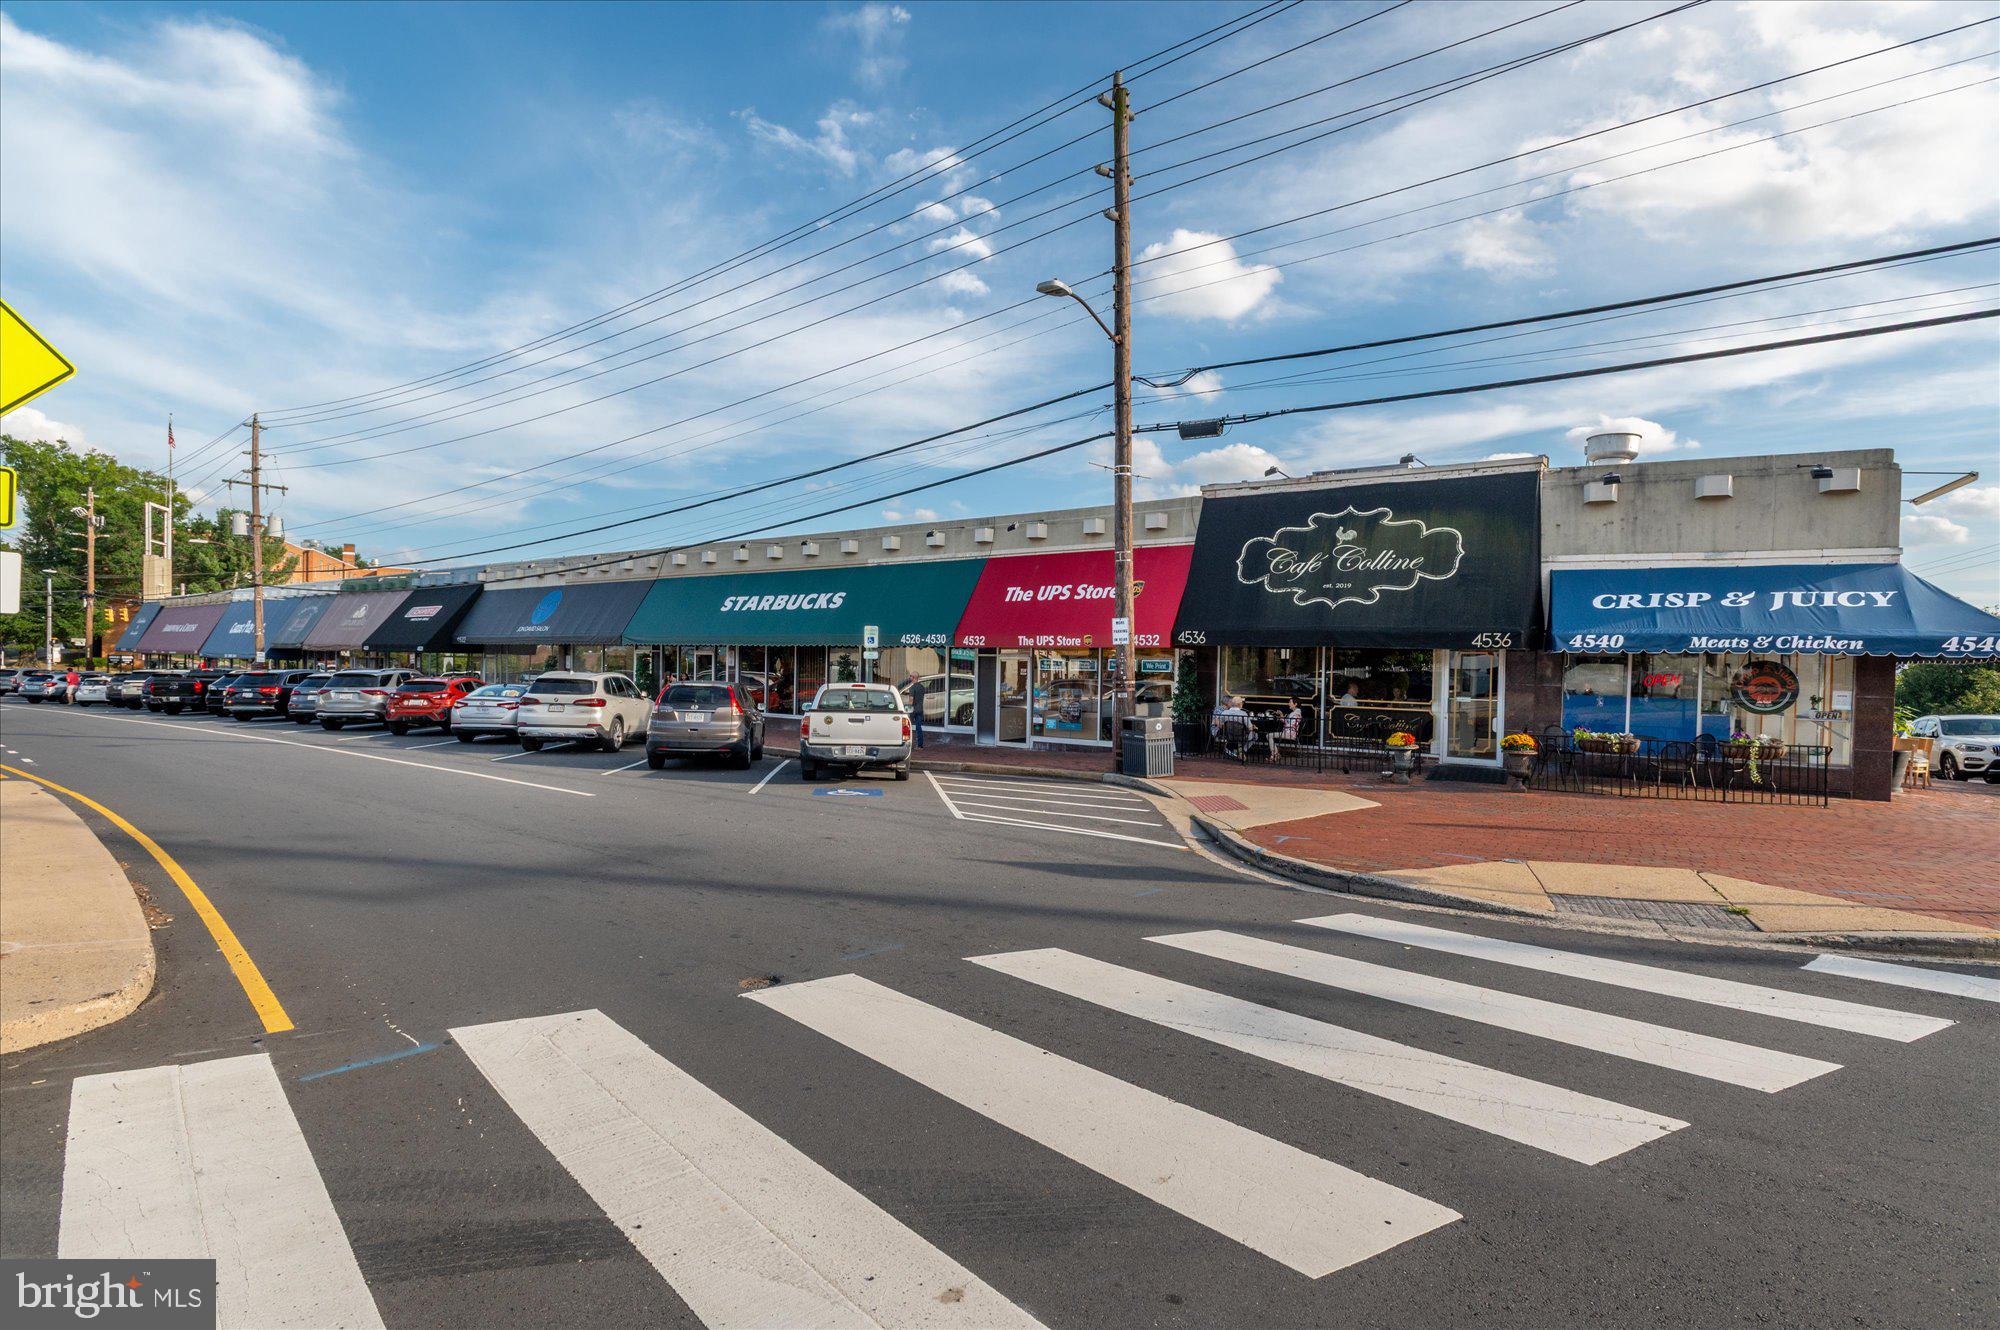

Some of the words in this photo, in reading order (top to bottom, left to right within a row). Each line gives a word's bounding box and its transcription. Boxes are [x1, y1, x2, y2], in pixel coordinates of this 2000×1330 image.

[1266, 547, 1329, 582] Café
[1332, 544, 1424, 572] Colline
[1004, 586, 1034, 602] The
[1037, 584, 1073, 601] UPS
[1074, 583, 1117, 600] Store
[720, 591, 847, 612] STARBUCKS
[1592, 591, 1712, 609] CRISP
[1720, 590, 1756, 607] &
[1769, 590, 1898, 612] JUICY
[962, 635, 986, 646] 4532
[1017, 635, 1036, 646] The
[1036, 635, 1054, 646] UPS
[1056, 635, 1081, 646] Store
[1133, 634, 1160, 646] 4532
[1177, 630, 1206, 644] 4536
[1471, 632, 1512, 648] 4536
[1569, 634, 1625, 648] 4540
[1689, 636, 1749, 649] Meats
[1752, 635, 1774, 649] &
[1775, 635, 1864, 650] Chicken
[1941, 636, 2000, 652] 454
[1643, 672, 1682, 687] OPEN
